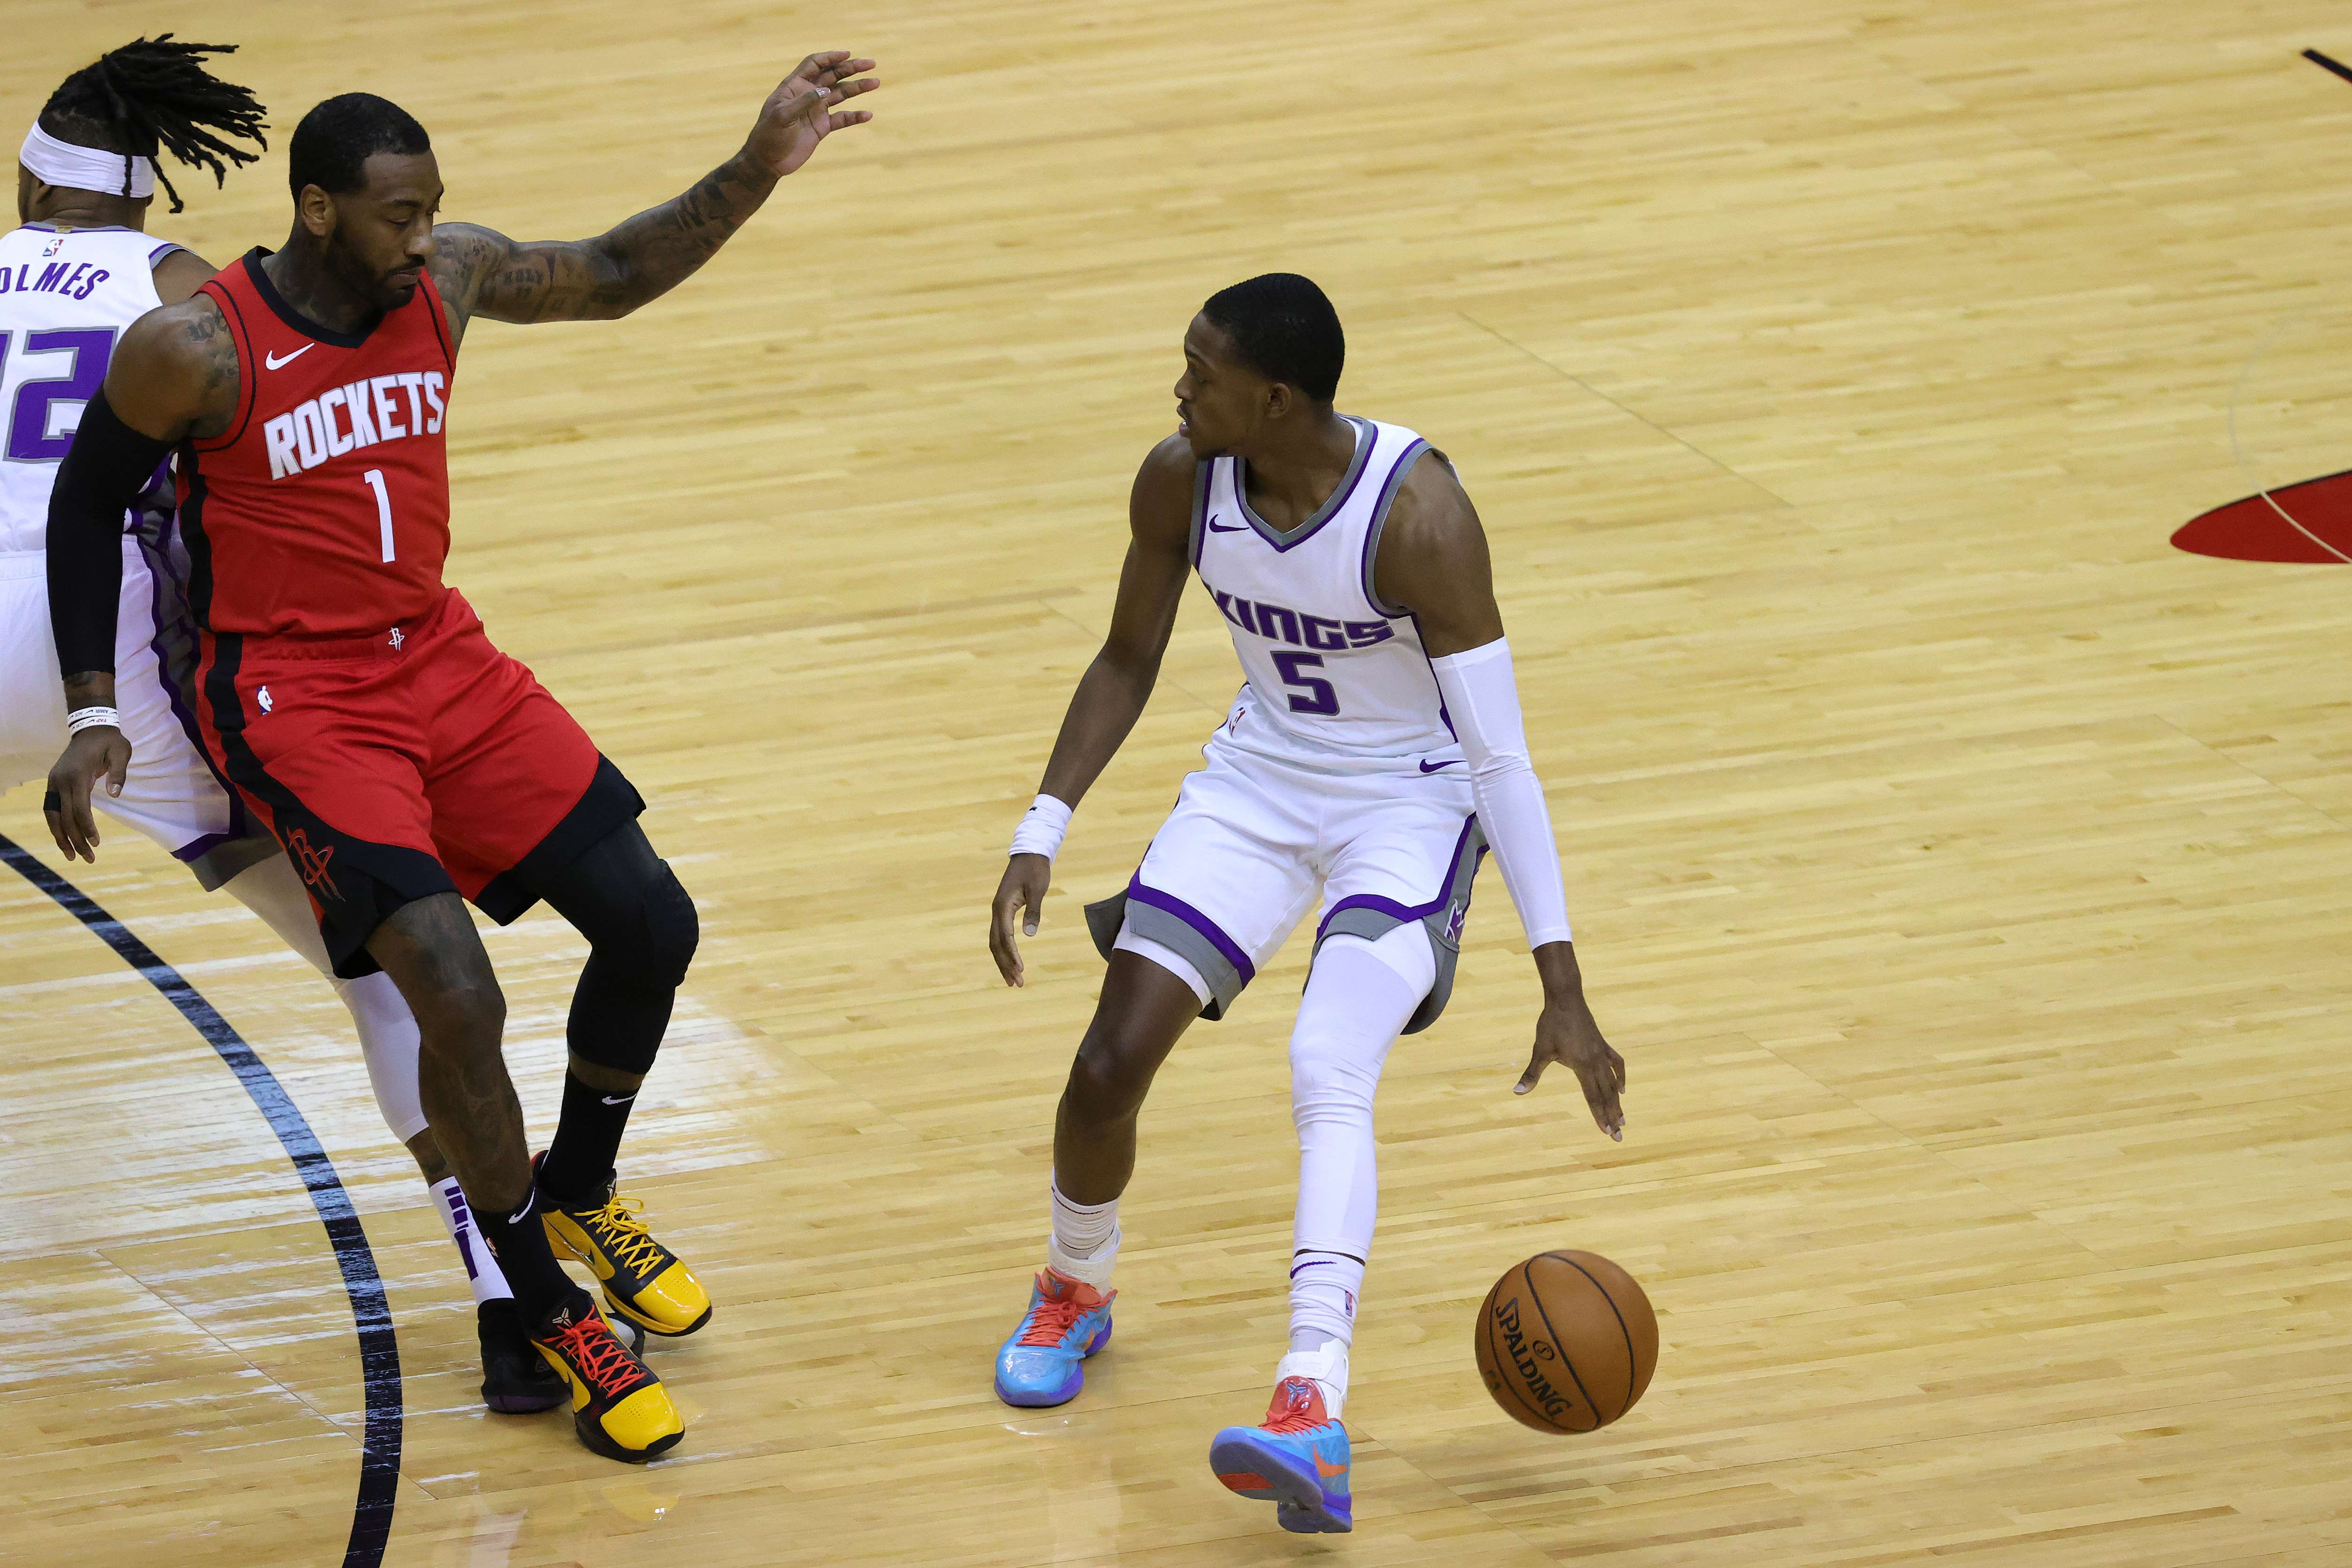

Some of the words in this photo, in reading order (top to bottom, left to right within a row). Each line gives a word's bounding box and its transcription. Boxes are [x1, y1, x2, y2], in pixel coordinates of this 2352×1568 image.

[0, 325, 119, 463] 2
[263, 371, 445, 481] ROCKETS
[364, 469, 395, 563] 1
[1270, 650, 1340, 716] 5
[1496, 1297, 1573, 1417] SPALDING
